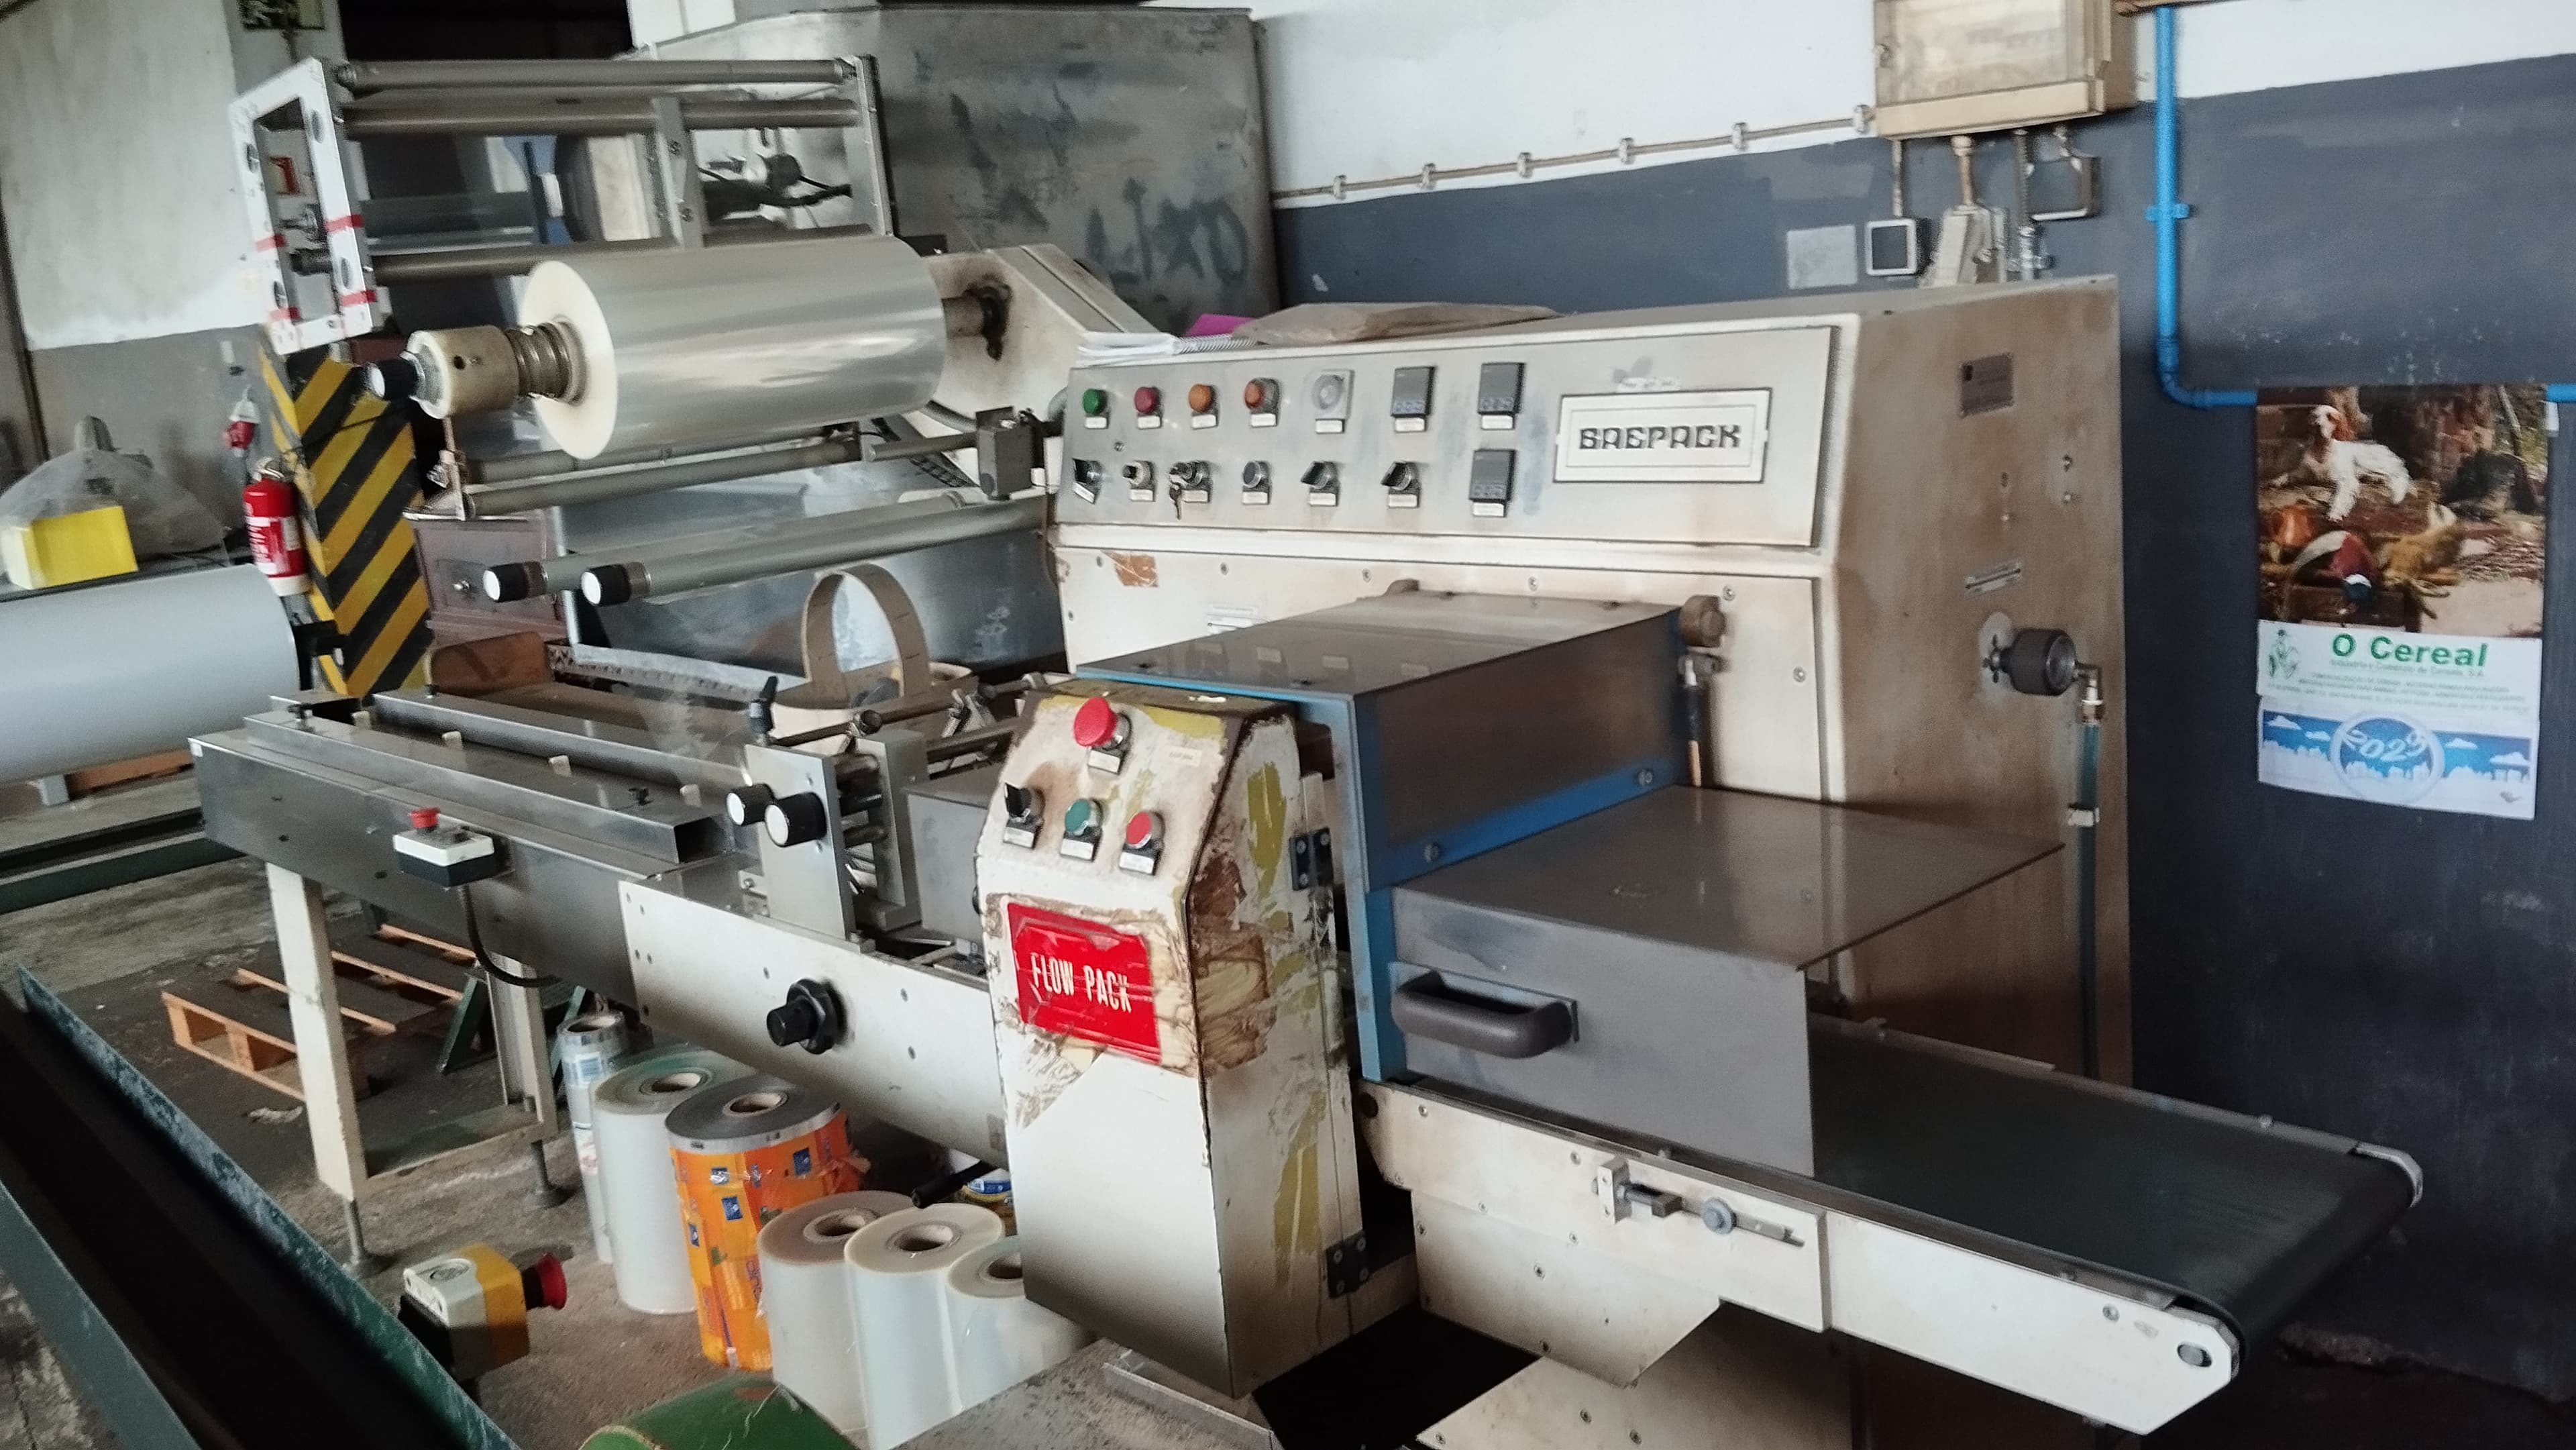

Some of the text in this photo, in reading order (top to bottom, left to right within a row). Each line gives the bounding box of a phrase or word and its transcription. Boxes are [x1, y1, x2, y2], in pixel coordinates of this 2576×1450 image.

[2332, 633, 2489, 668] O Cereal
[1030, 951, 1132, 1013] FLOW PACK
